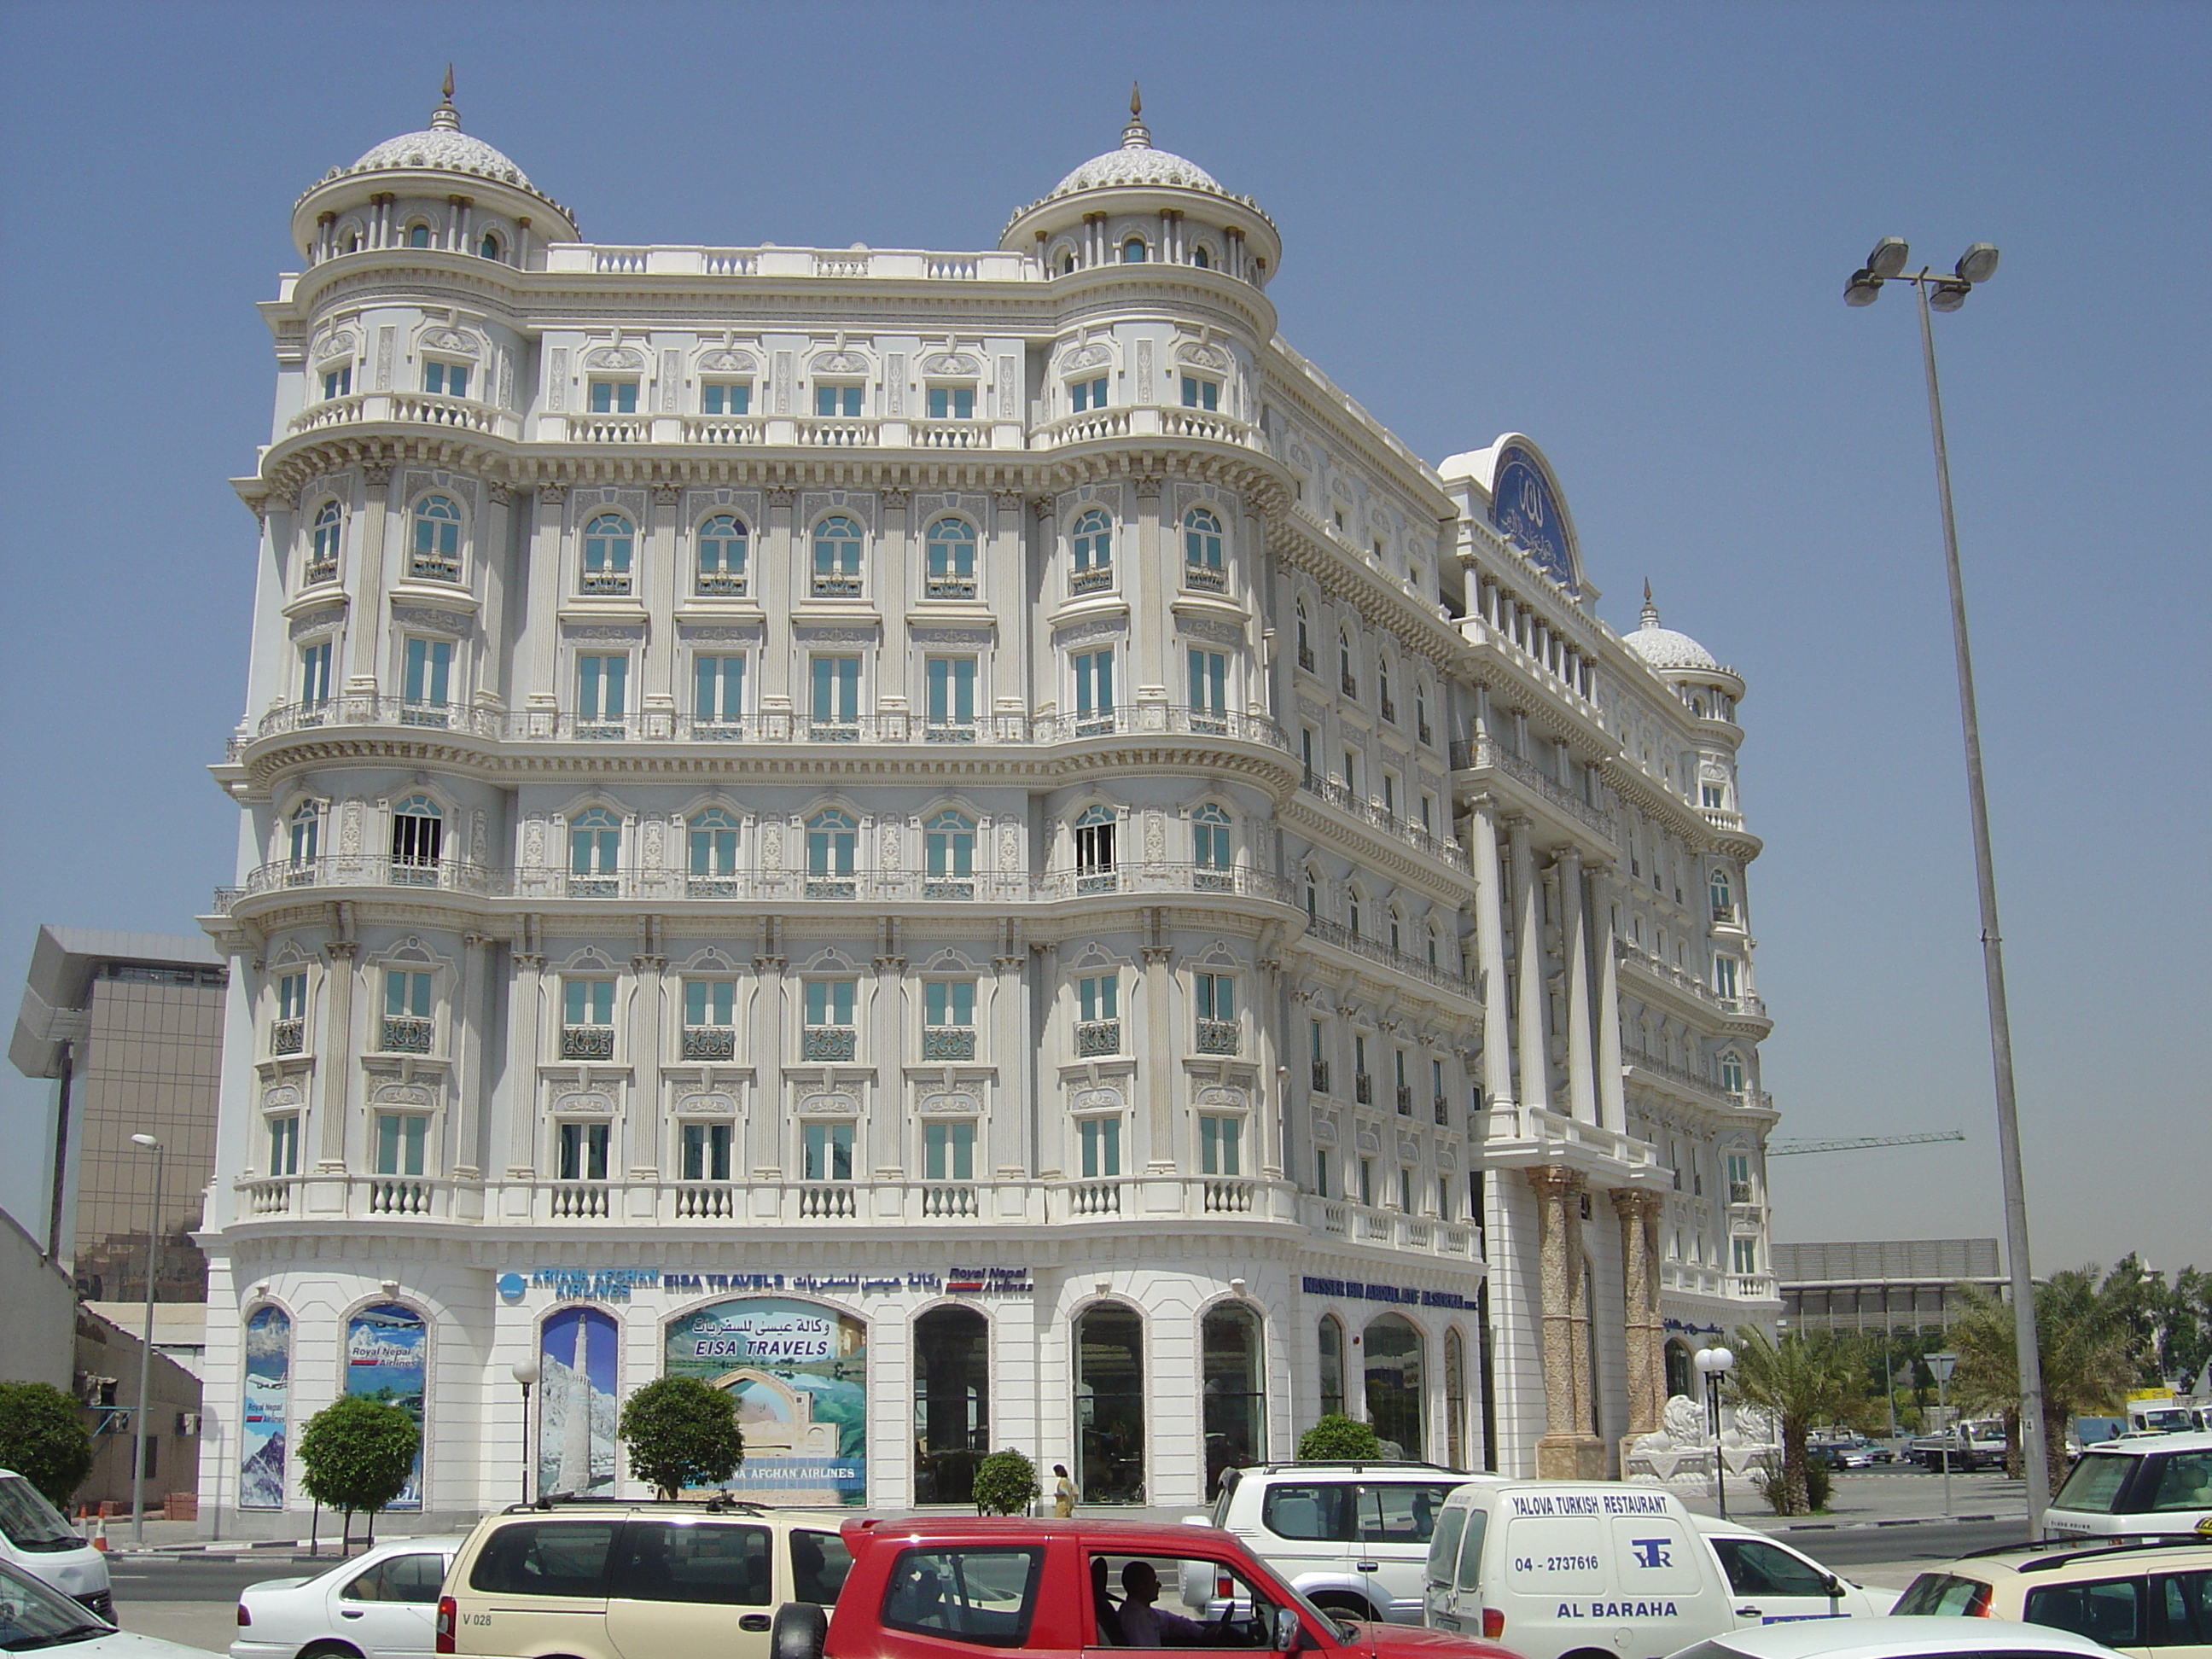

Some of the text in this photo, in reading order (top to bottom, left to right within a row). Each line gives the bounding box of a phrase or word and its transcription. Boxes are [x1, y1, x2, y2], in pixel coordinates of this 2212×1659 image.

[533, 1269, 660, 1283] ARIANA AFGHAN
[664, 1274, 785, 1287] EISA TRAVELS
[793, 1272, 859, 1289] للسفريات
[907, 1272, 941, 1289] وكالة
[949, 1267, 1027, 1283] Royal Nepal
[555, 1284, 631, 1296] AIRLINES
[982, 1280, 1033, 1292] Airlines
[1303, 1277, 1345, 1296] NASSER
[1346, 1282, 1365, 1299] BIN
[692, 1318, 830, 1336] وكالة عيسى للسفريات
[352, 1348, 411, 1360] Royal Nepal
[696, 1341, 828, 1355] EISA TRAVELS
[247, 1403, 282, 1413] Royal Nepal
[263, 1415, 285, 1423] Airlines
[752, 1469, 798, 1479] AFGHAN
[800, 1469, 854, 1478] AIRLINES
[1512, 1496, 1667, 1515] YALOVA TURKISH RESTAURANT
[1515, 1557, 1533, 1572] 04
[1547, 1555, 1598, 1571] 2737616
[1557, 1601, 1678, 1618] AL BARAHA
[463, 1613, 492, 1626] V 028
